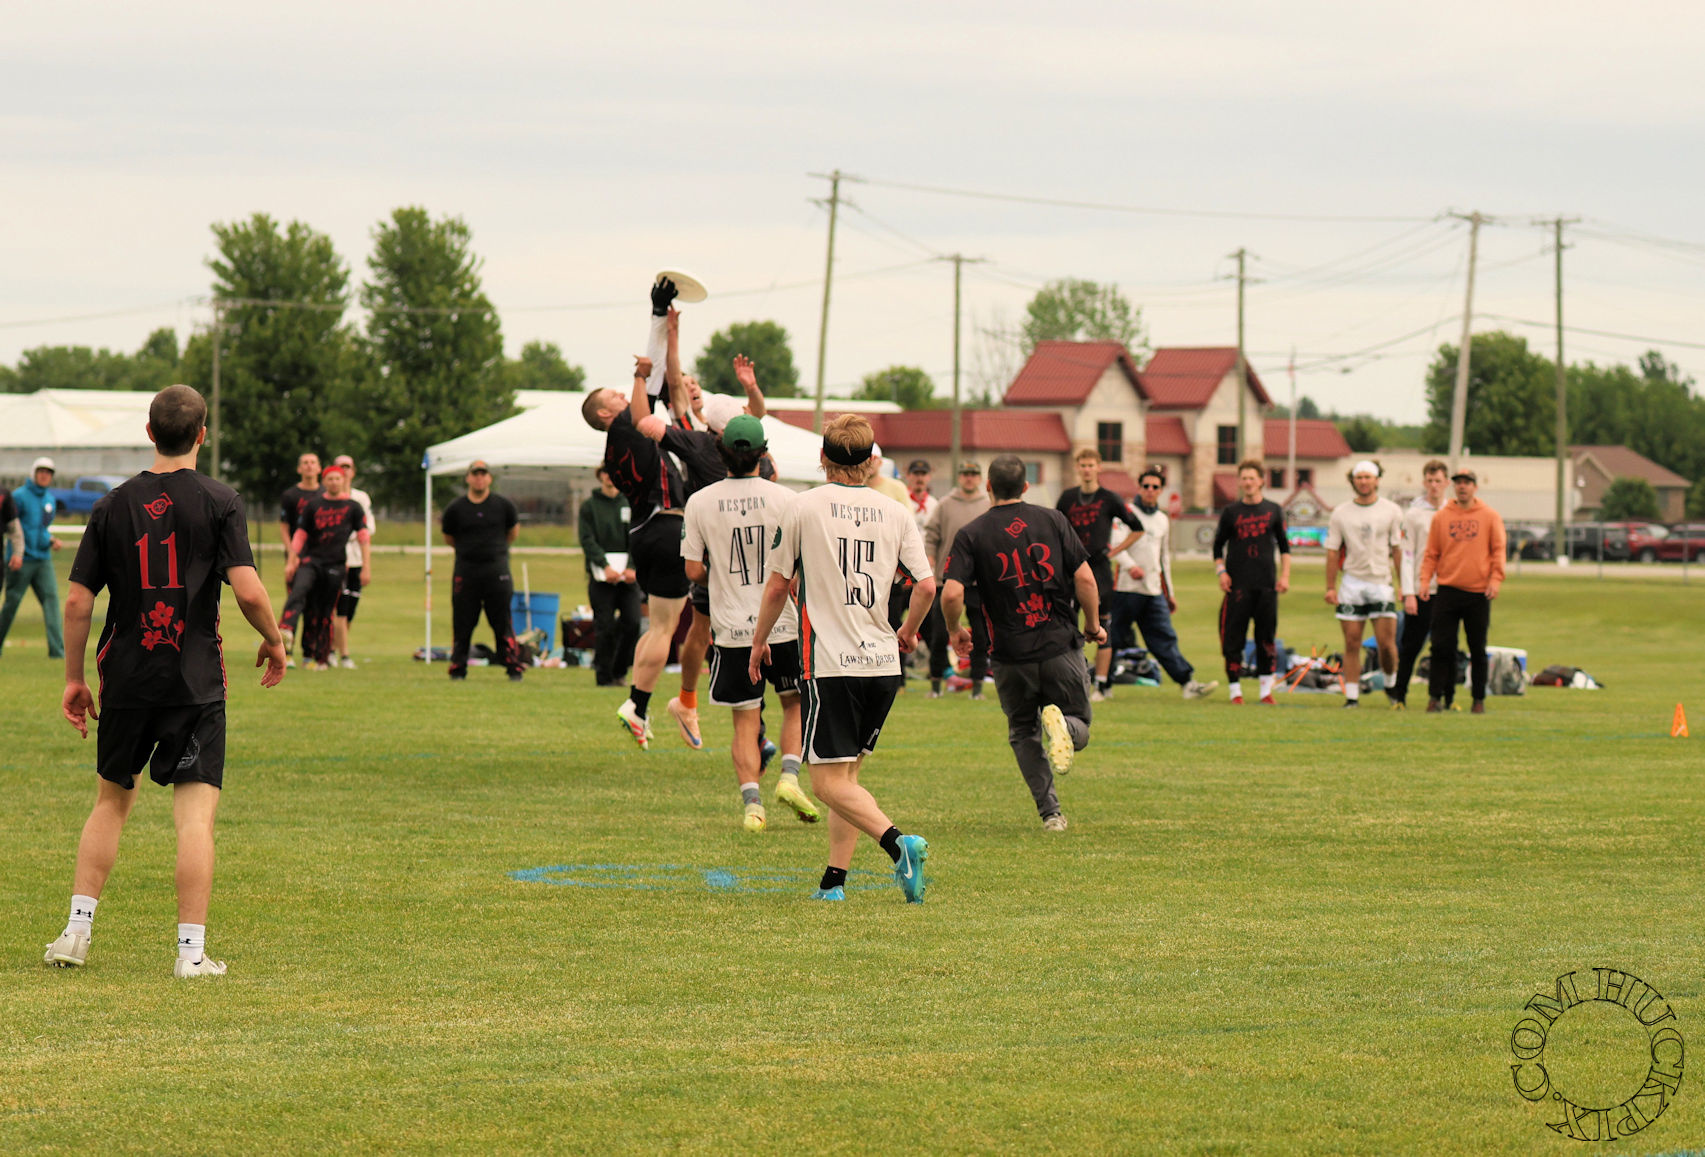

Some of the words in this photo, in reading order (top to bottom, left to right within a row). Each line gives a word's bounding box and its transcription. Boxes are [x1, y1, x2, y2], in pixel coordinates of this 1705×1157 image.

[718, 496, 766, 516] WESTERN
[830, 502, 884, 527] WESTERN
[135, 531, 184, 589] 11
[729, 525, 765, 586] 47
[837, 537, 875, 608] 15
[996, 542, 1054, 589] 43
[840, 651, 864, 668] LAWN
